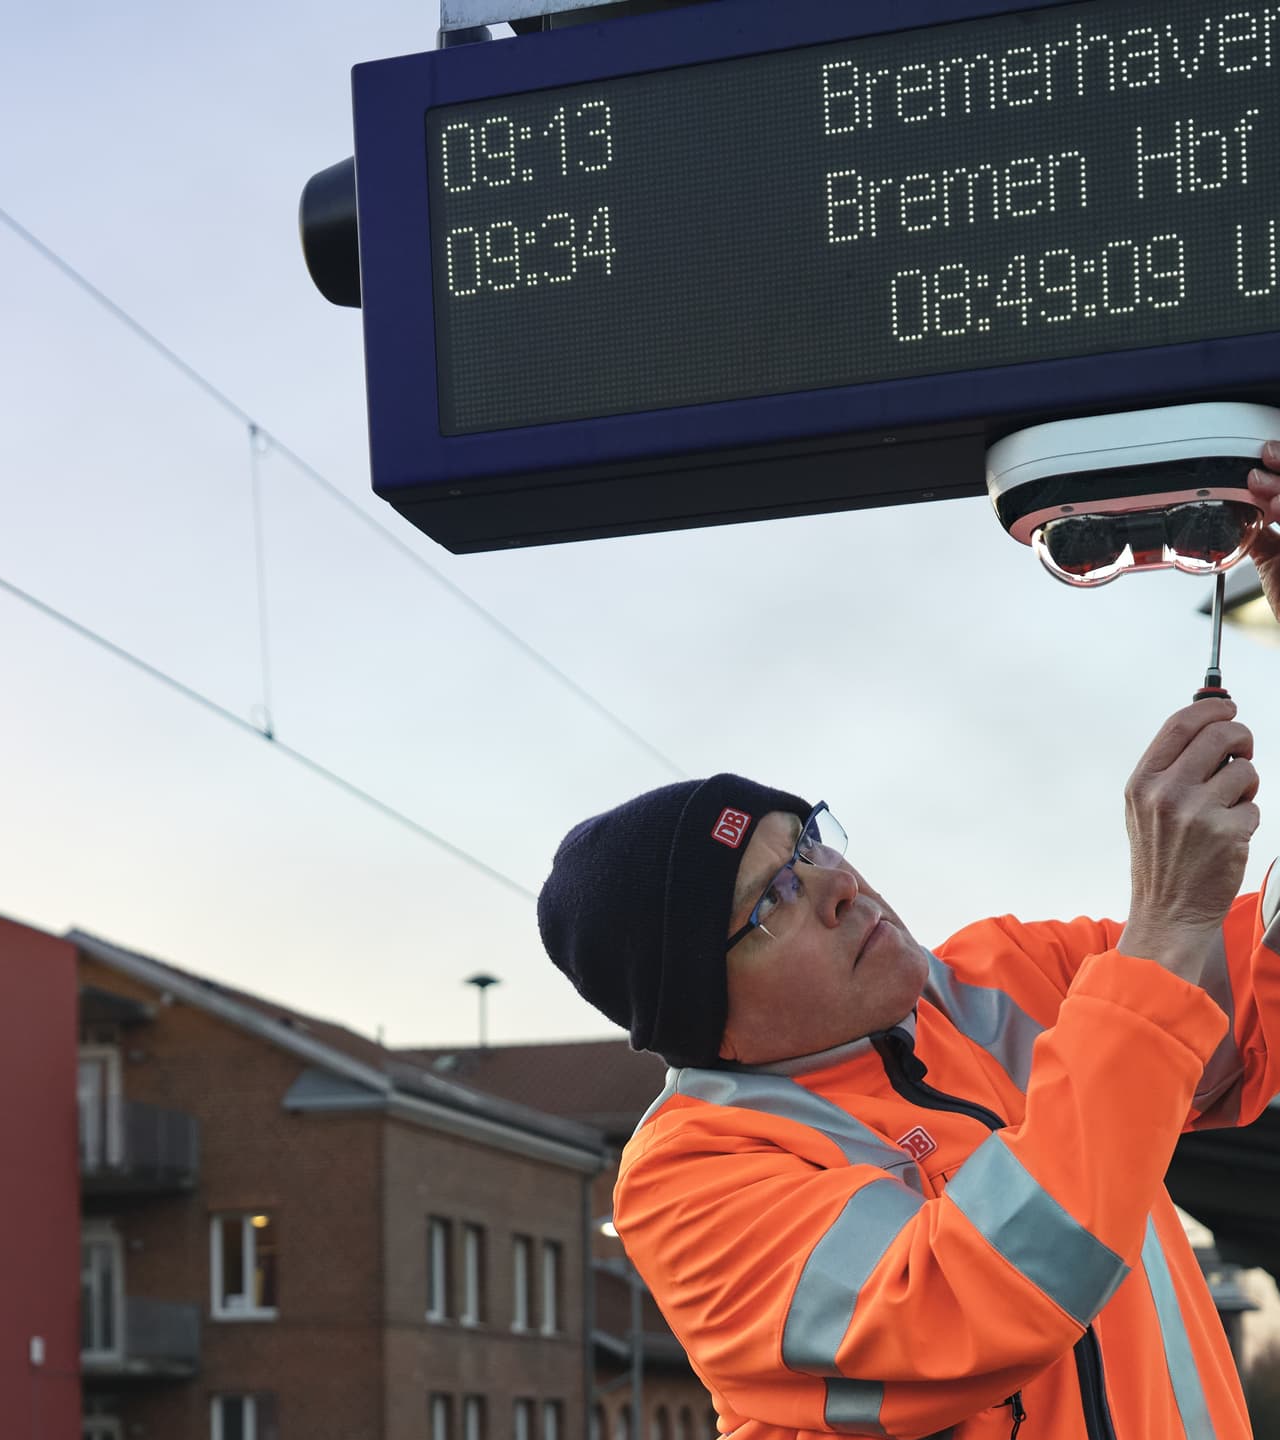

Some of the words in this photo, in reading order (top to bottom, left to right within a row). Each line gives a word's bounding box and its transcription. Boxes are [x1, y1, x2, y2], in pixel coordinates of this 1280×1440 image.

[441, 100, 613, 193] 09:13
[446, 206, 617, 297] 09:34
[826, 150, 1087, 245] Bremen
[1136, 108, 1259, 199] Hbf
[891, 233, 1186, 342] 08:49:09
[717, 810, 747, 844] DB
